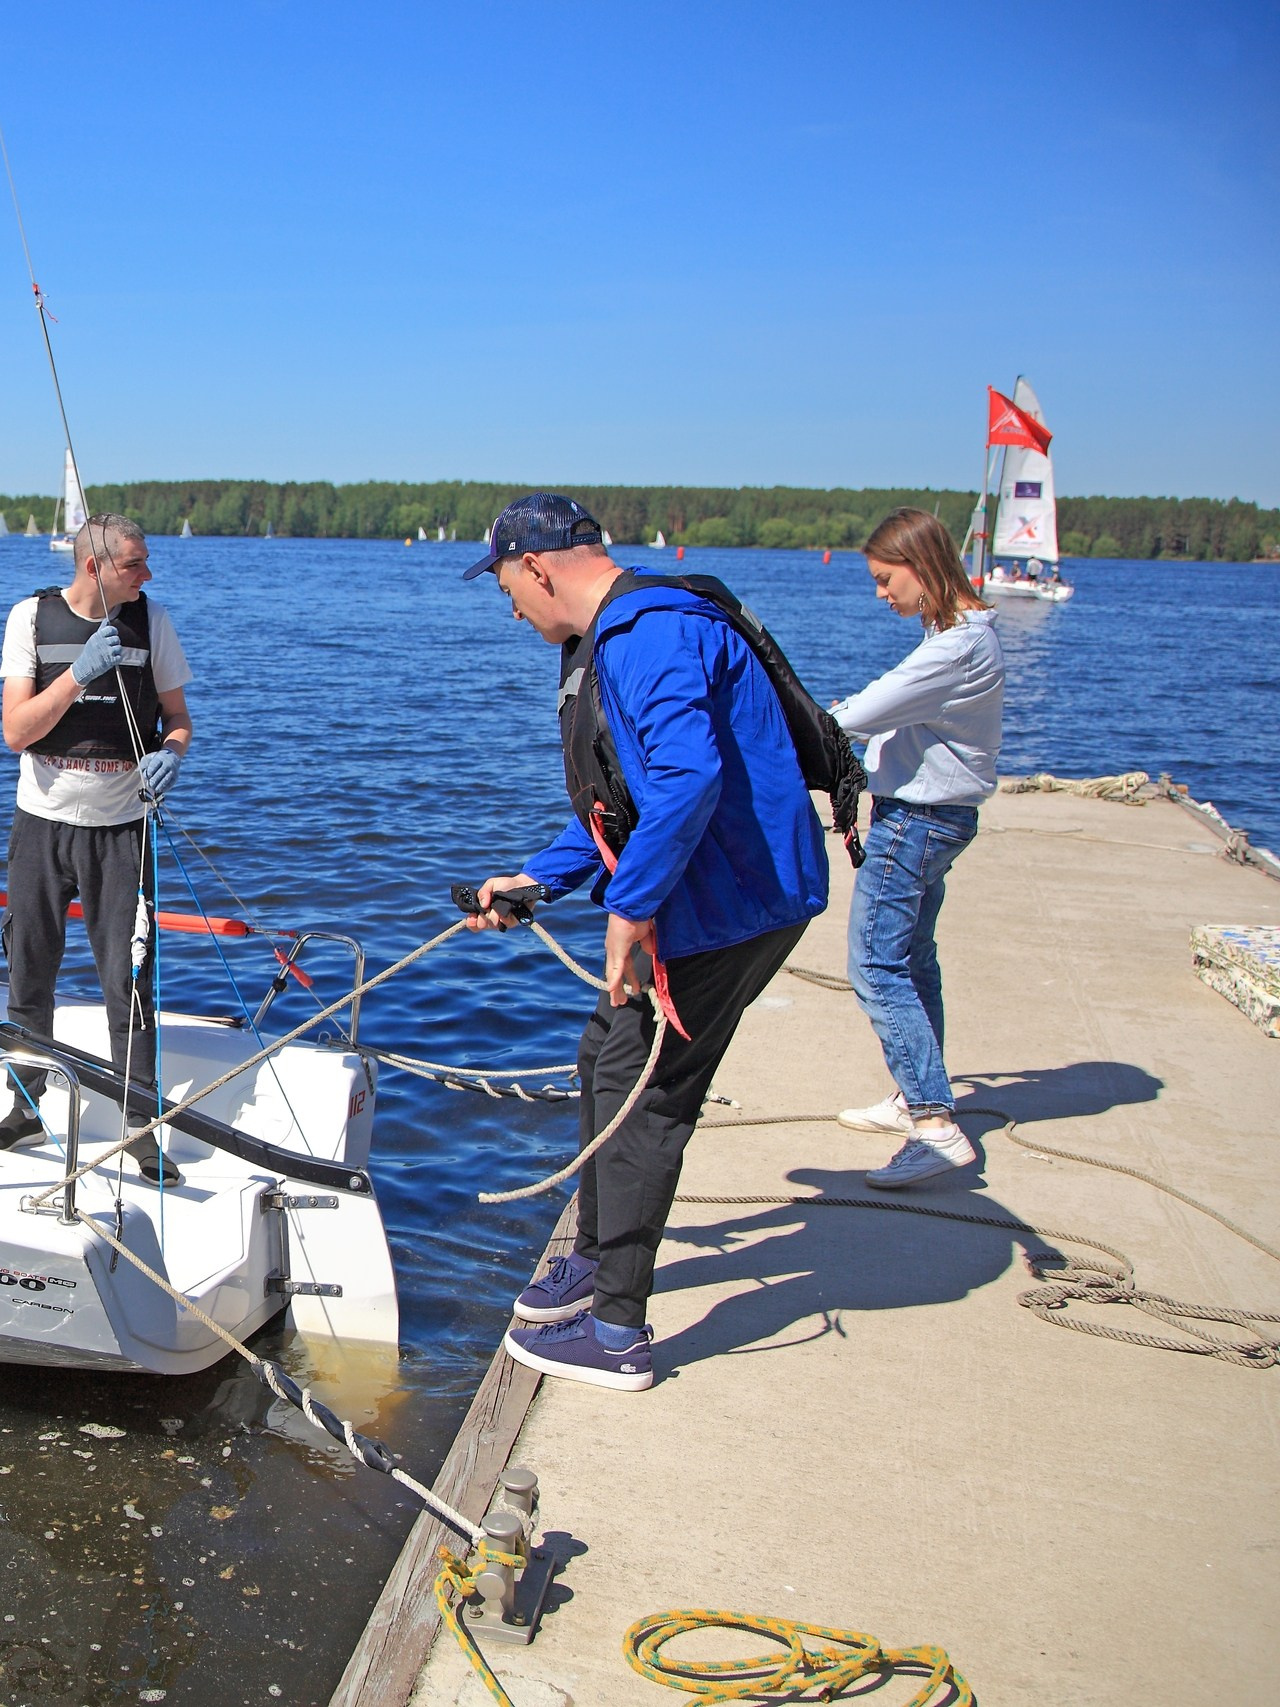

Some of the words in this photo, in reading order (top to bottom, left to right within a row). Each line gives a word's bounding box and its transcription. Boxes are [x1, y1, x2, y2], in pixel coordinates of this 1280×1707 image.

[66, 757, 91, 772] HAVE
[94, 760, 120, 773] SOME
[349, 1090, 366, 1119] 112
[13, 1270, 47, 1281] BOATS
[12, 1298, 75, 1314] CARBON
